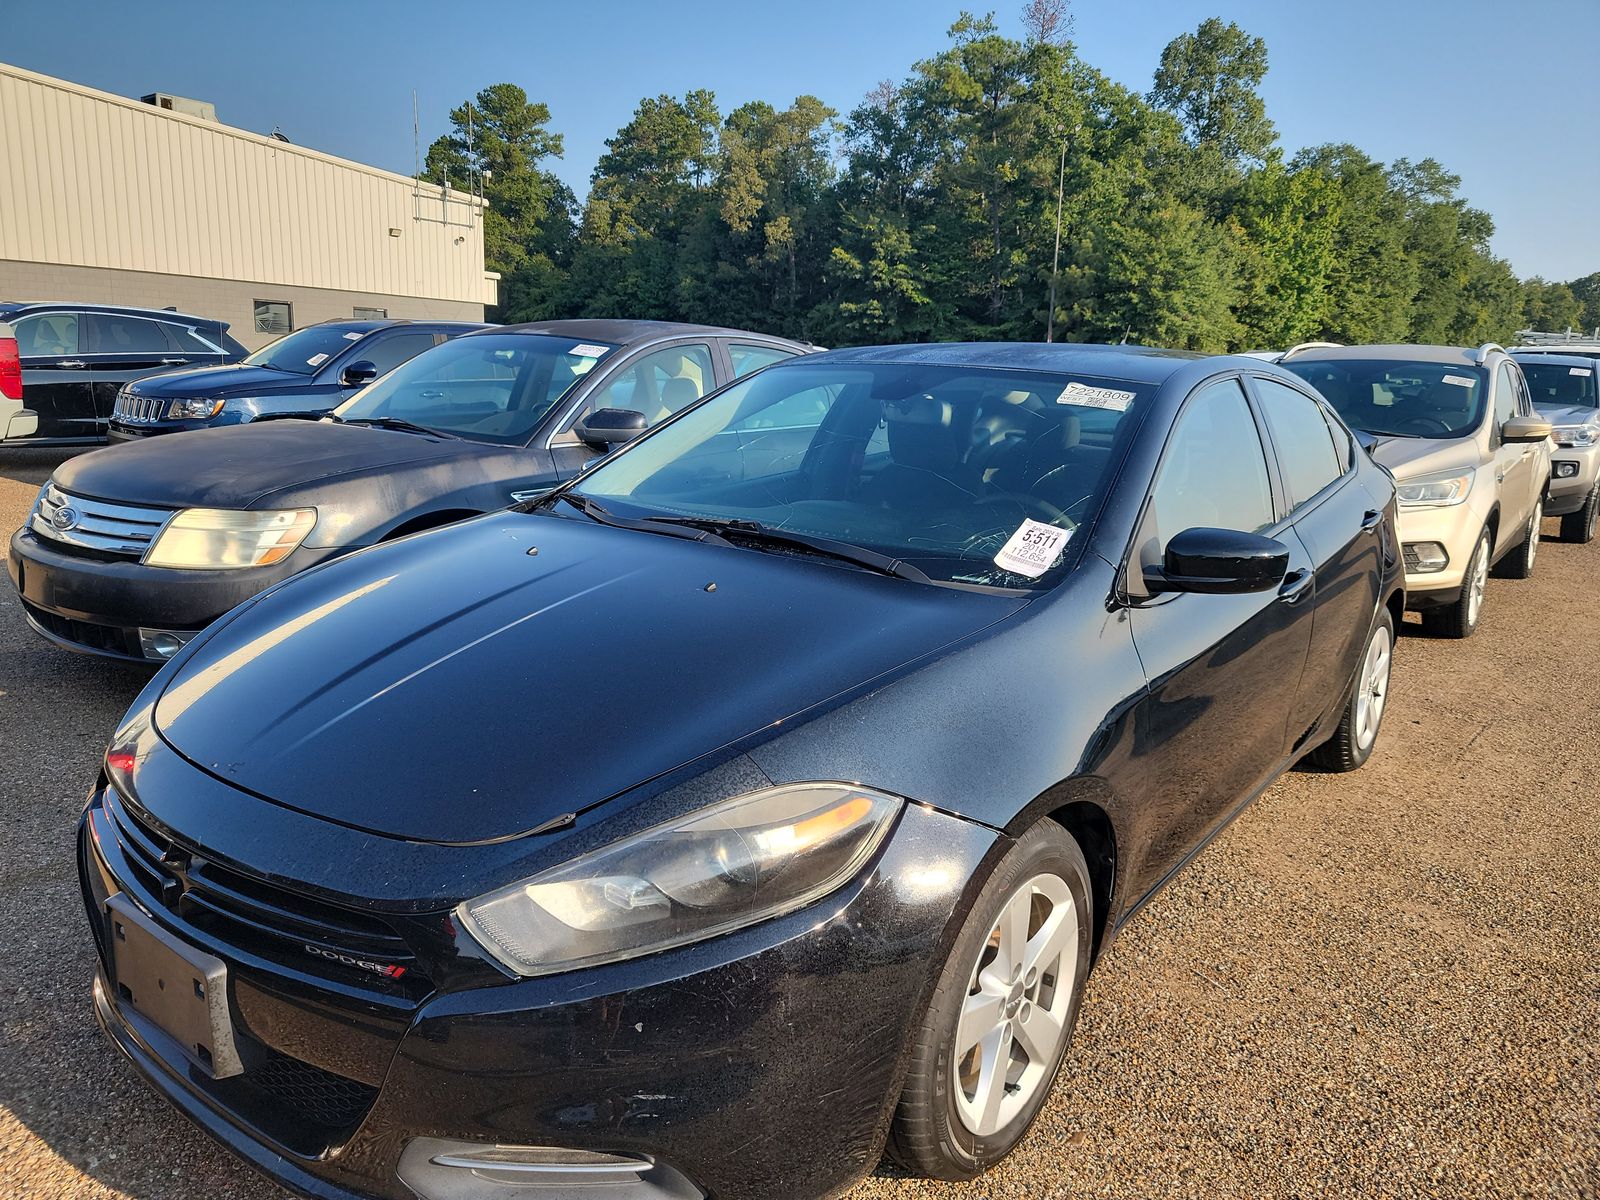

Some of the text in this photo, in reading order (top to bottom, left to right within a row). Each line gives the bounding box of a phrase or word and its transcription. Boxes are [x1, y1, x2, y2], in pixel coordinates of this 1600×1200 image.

[1068, 385, 1130, 401] 7221809
[1022, 529, 1059, 549] 5:511
[1011, 547, 1047, 563] 112,654
[1022, 543, 1047, 555] 2016
[305, 944, 392, 975] DODGE
